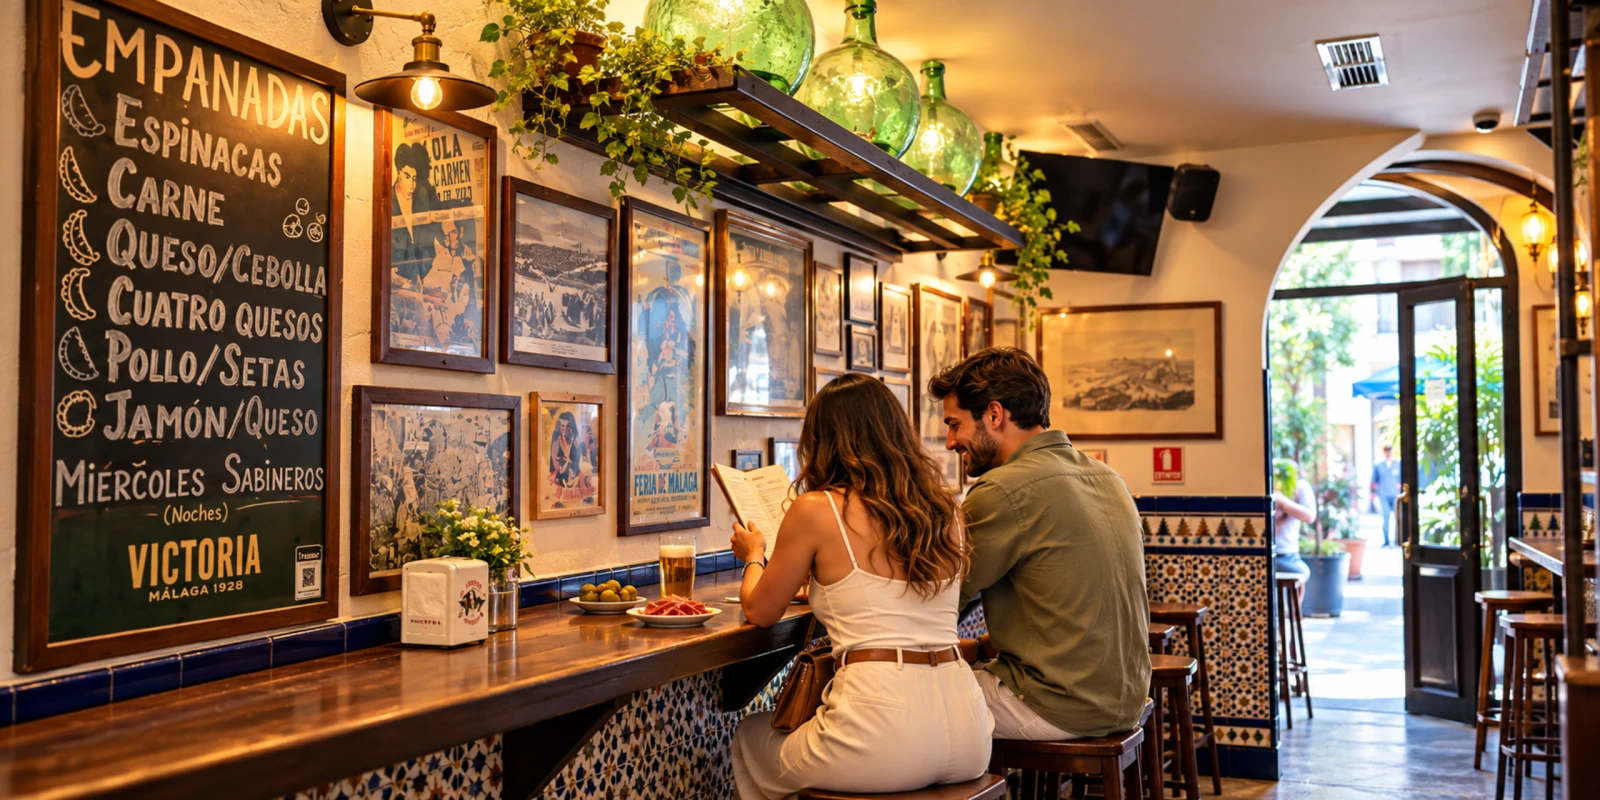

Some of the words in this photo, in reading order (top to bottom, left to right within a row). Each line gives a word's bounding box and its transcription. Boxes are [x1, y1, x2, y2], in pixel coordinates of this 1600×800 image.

[60, 3, 329, 145] EMPANADAS
[107, 157, 225, 226] CARNE
[433, 159, 471, 187] CARMEN
[106, 218, 327, 296] QUESO/CEBOLLA
[107, 275, 226, 332] CUATRO
[235, 302, 323, 343] QUESOS
[105, 329, 305, 390] POLLO/SETAS
[102, 389, 318, 440] JAMÓN/QUESO
[634, 473, 657, 496] FERIA
[163, 502, 229, 526] (Noches)
[128, 534, 261, 589] VICTORIA
[148, 582, 209, 602] MÁLAGA
[213, 580, 244, 595] 1928
